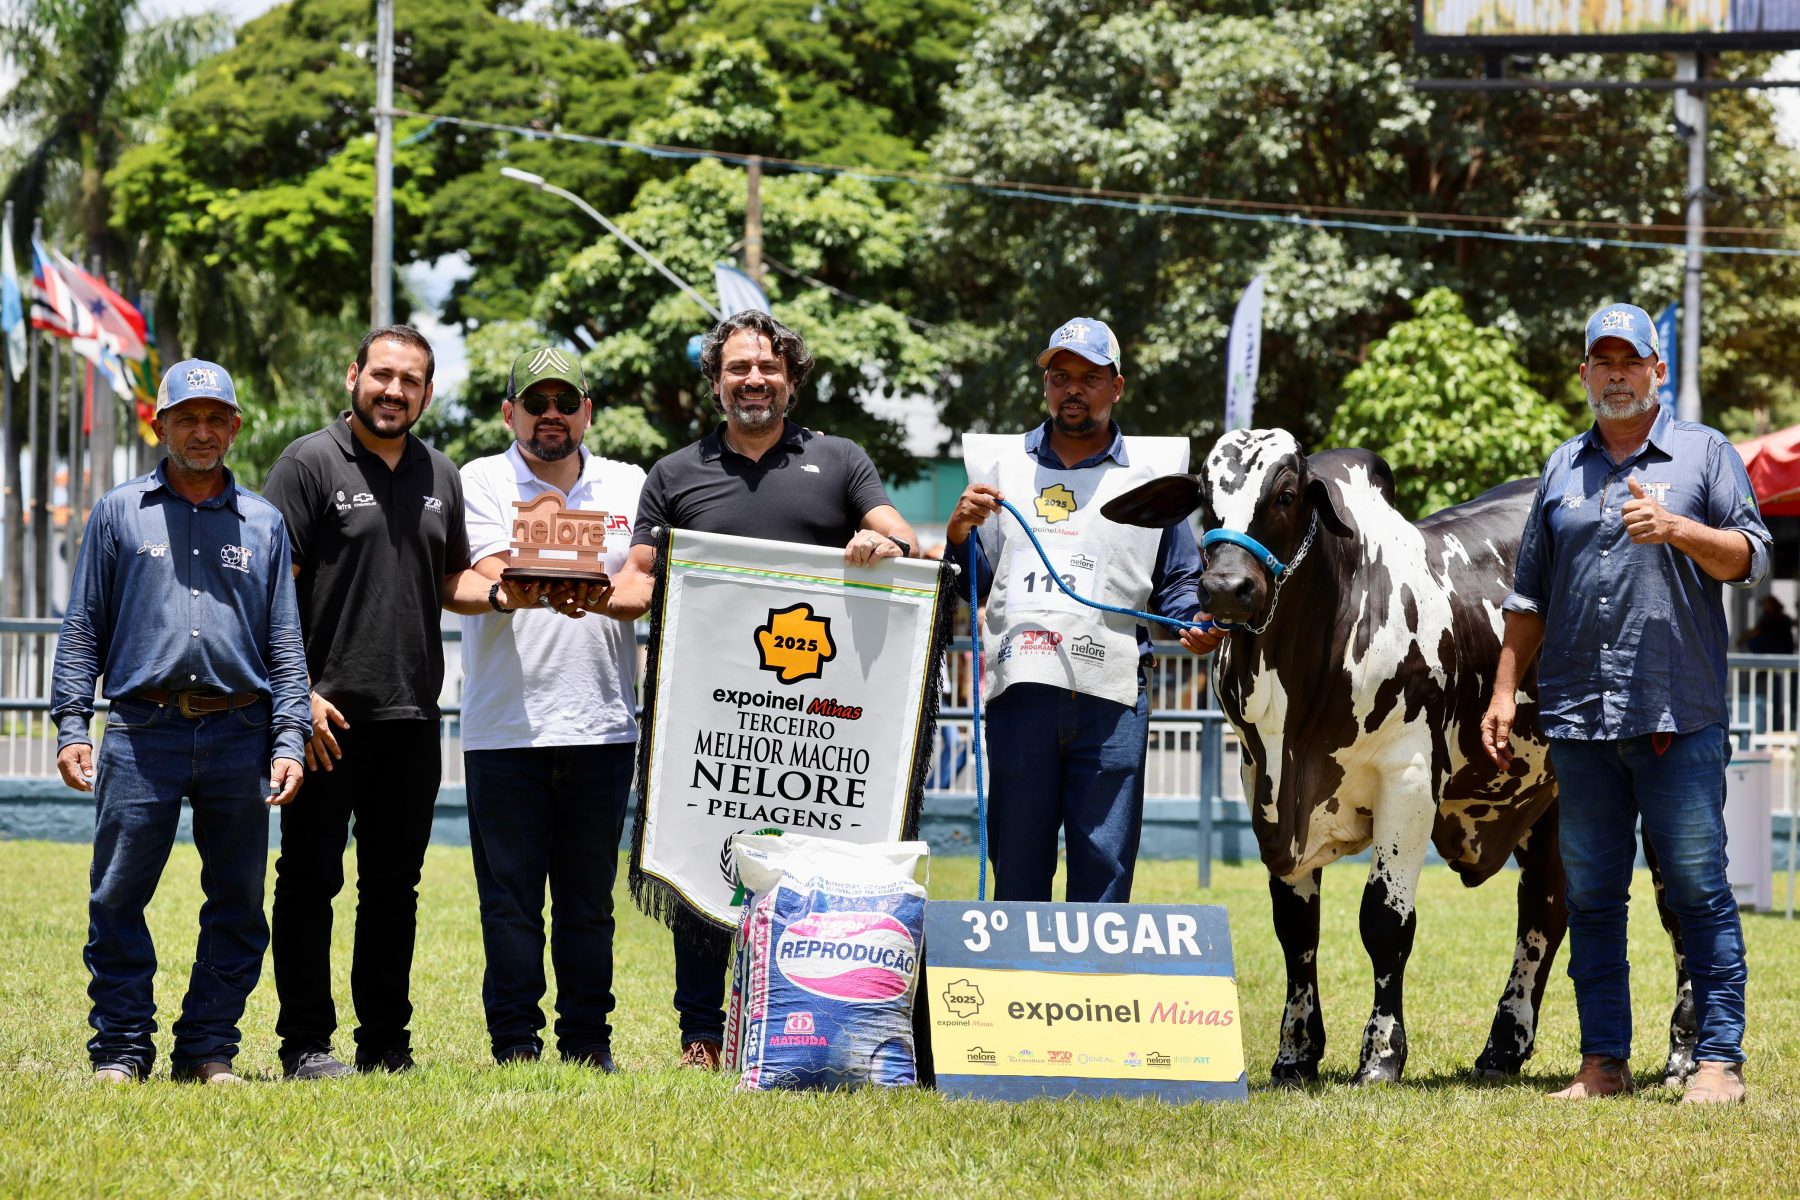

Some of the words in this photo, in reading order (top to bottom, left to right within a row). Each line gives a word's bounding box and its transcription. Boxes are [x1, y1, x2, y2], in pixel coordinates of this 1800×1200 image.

[1045, 499, 1067, 508] 2025
[512, 513, 606, 546] nelore
[1070, 558, 1094, 569] nelore
[1023, 571, 1077, 595] 113
[773, 635, 818, 653] 2025
[1071, 643, 1105, 658] nelore
[712, 688, 805, 712] expoinel
[806, 697, 863, 720] Minas
[736, 711, 835, 740] TERCEIRO
[694, 729, 784, 765] MELHOR
[788, 740, 870, 775] MACHO
[690, 759, 867, 808] NELORE
[707, 798, 842, 831] PELAGENS
[1025, 910, 1202, 956] LUGAR
[780, 940, 916, 976] REPRODUÇÃO
[950, 995, 976, 1004] 2025
[937, 1020, 970, 1028] expoinel
[1008, 998, 1141, 1026] expoinel
[1150, 1001, 1234, 1027] Minas
[769, 1035, 829, 1047] MATSUDA
[967, 1052, 996, 1061] nelore
[1146, 1056, 1171, 1064] nelore
